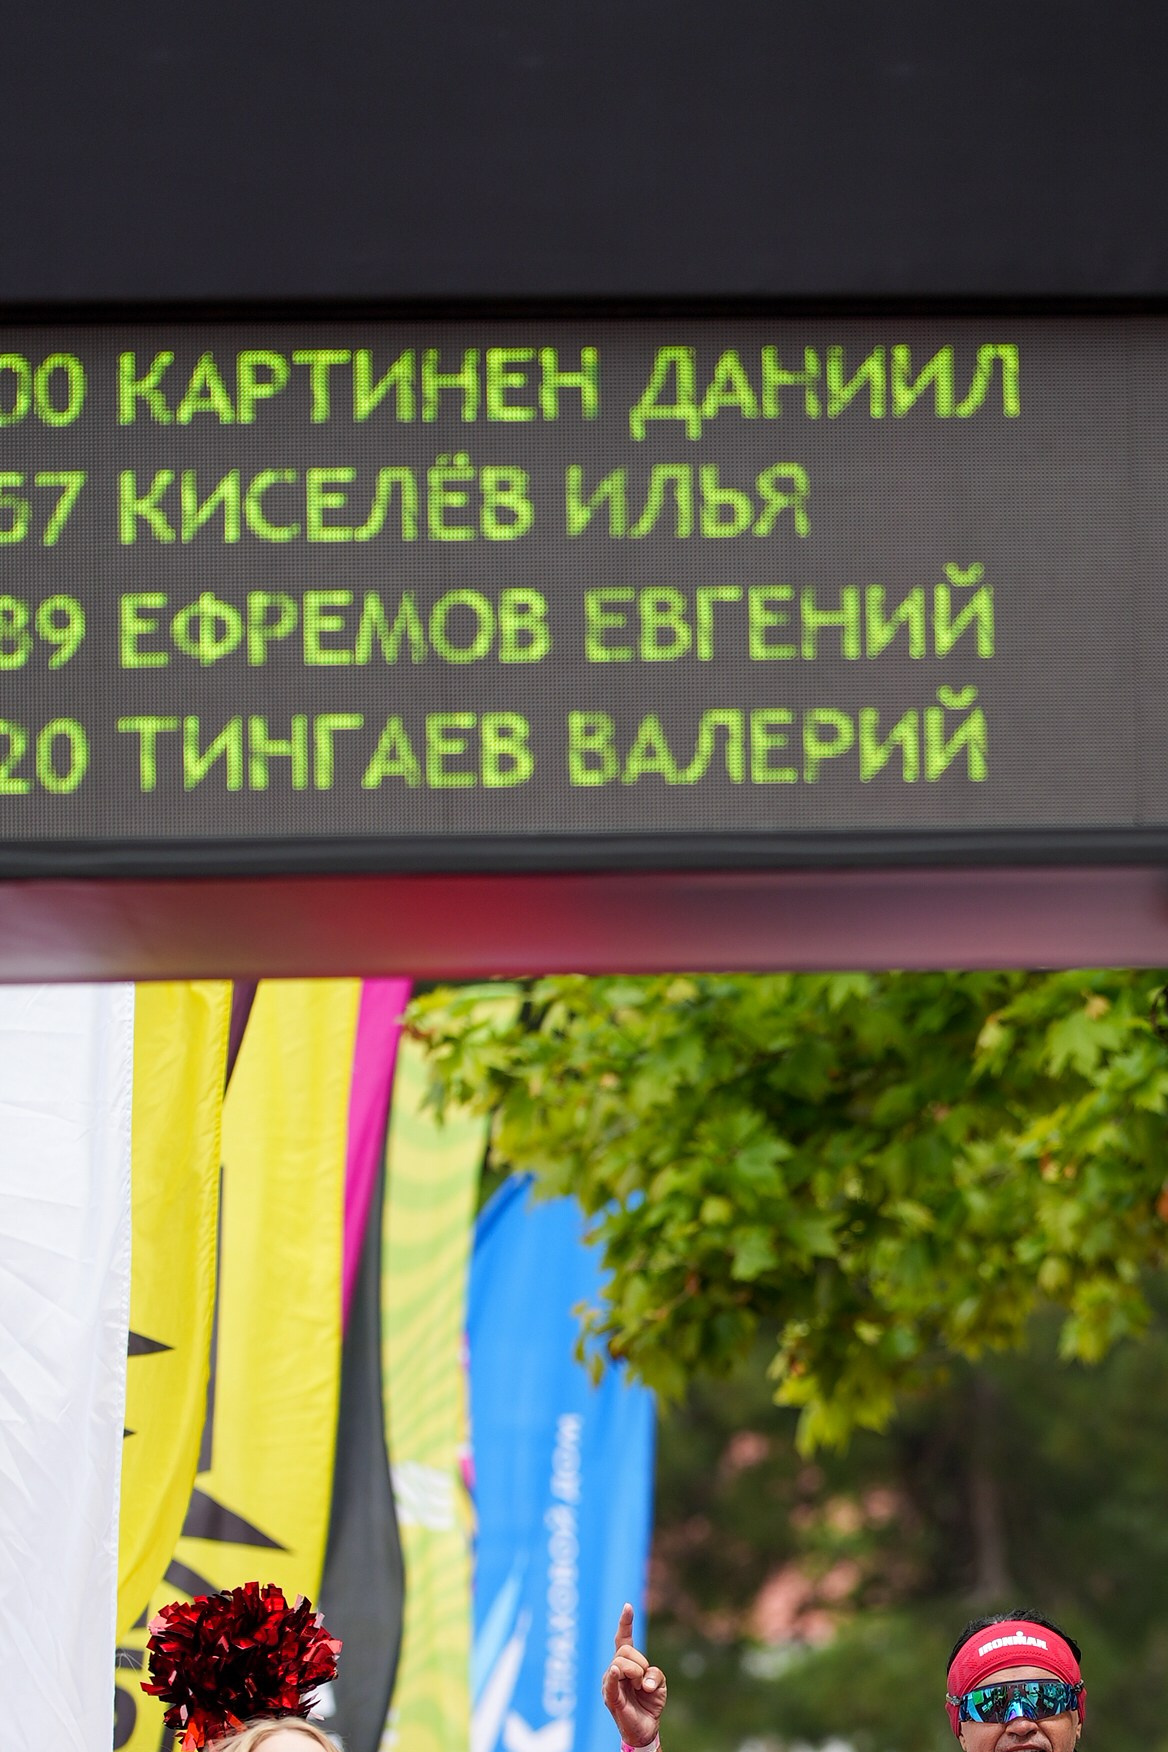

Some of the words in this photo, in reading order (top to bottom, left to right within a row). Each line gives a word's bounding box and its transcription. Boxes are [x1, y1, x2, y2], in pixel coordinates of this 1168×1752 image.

[118, 346, 600, 427] КАРТИНЕН
[630, 344, 1021, 441] ДАНИИЛ
[118, 453, 535, 545] КИСЕЛЁВ
[566, 462, 811, 539] ИЛЬЯ
[119, 588, 553, 669] ЕФРЕМОВ
[585, 564, 995, 663] ЕВГЕНИЙ
[117, 712, 536, 792] ТИНГАЕВ
[568, 686, 989, 787] ВАЛЕРИЙ
[978, 1631, 1049, 1657] IRONMAN
